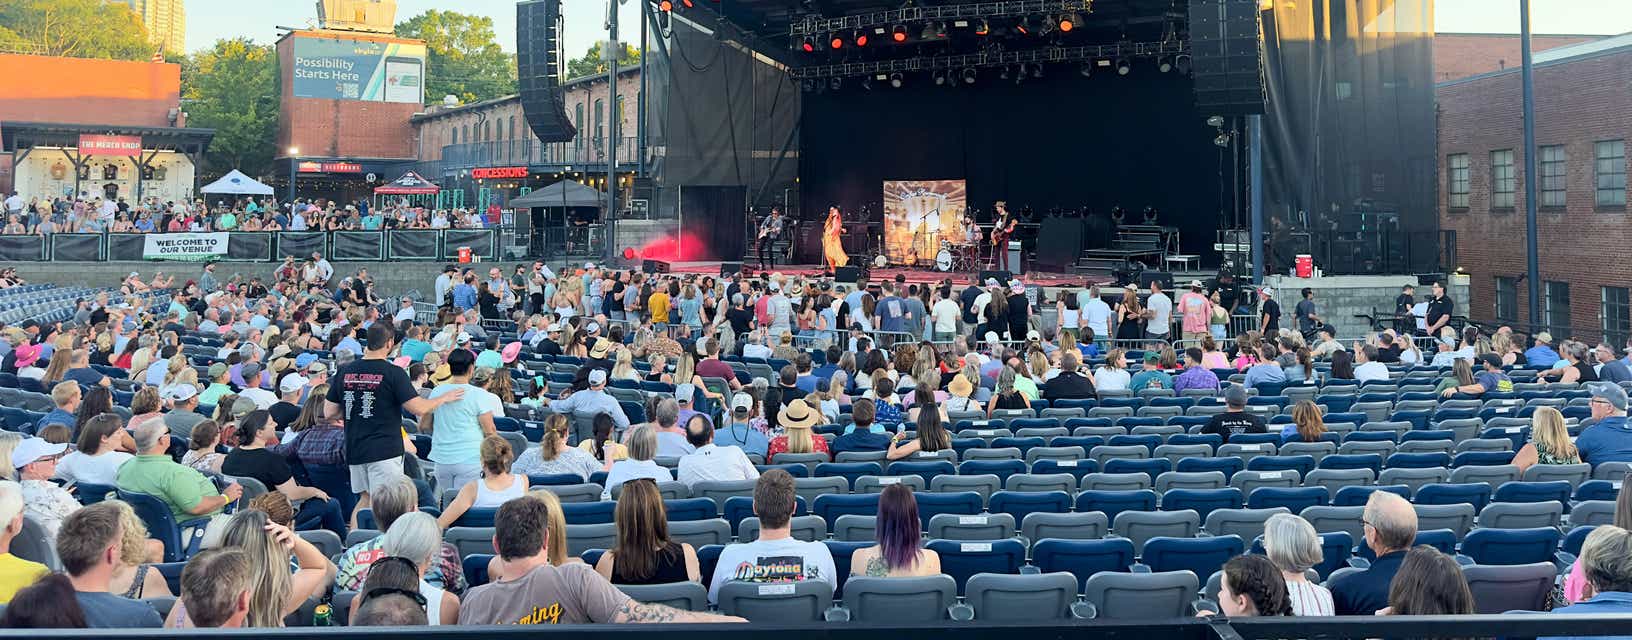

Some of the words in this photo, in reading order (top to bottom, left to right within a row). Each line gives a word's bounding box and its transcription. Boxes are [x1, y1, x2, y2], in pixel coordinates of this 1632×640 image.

[295, 57, 354, 71] Possibility
[295, 69, 330, 80] Starts
[332, 69, 359, 81] Here
[472, 168, 527, 178] CONCESSIONS
